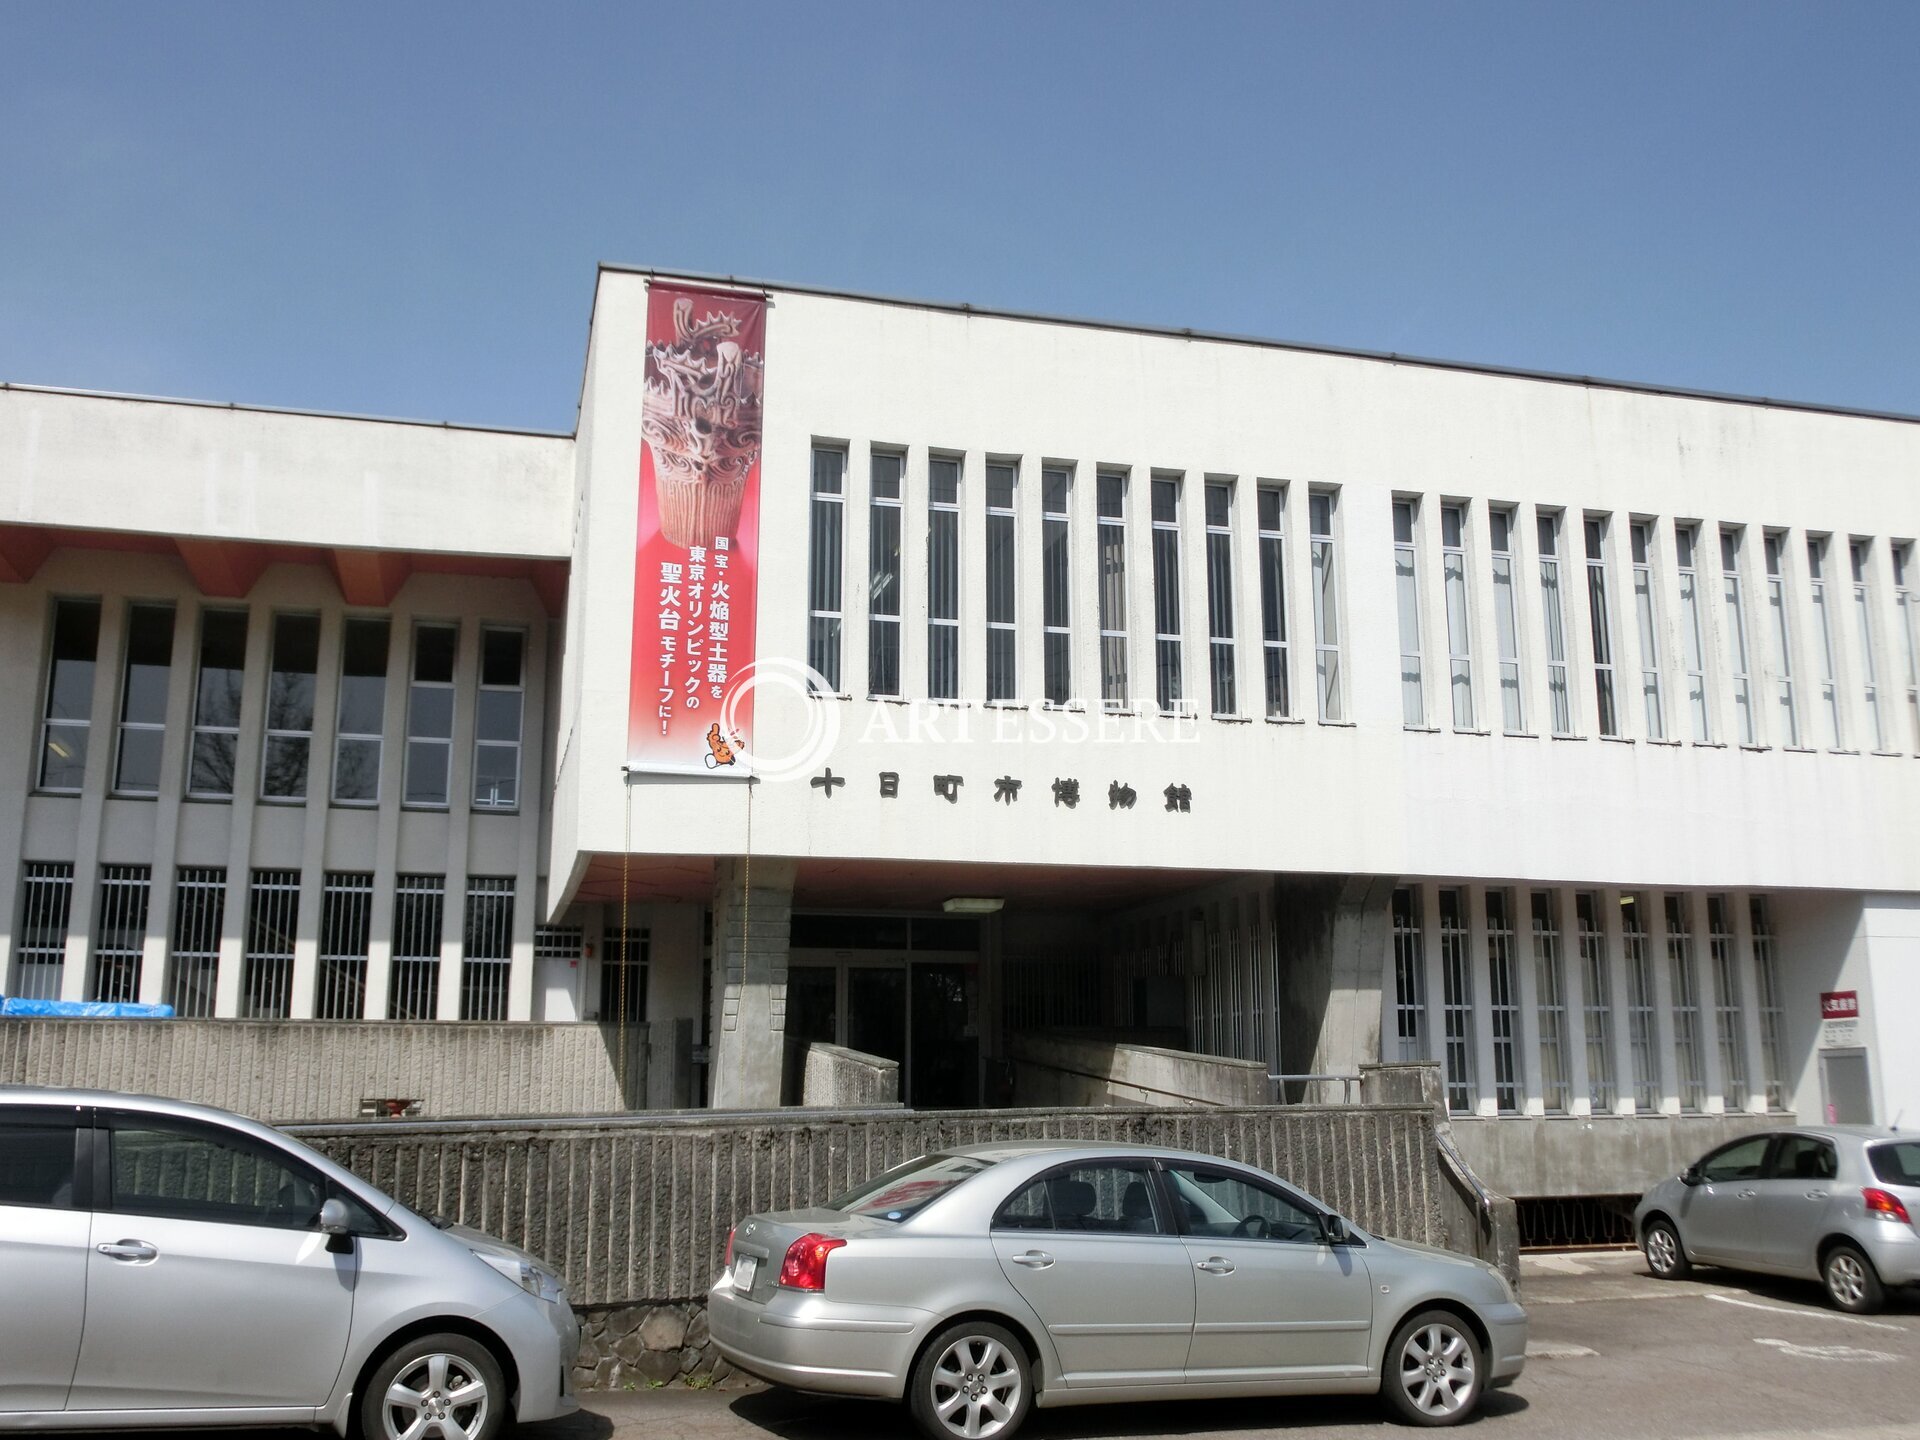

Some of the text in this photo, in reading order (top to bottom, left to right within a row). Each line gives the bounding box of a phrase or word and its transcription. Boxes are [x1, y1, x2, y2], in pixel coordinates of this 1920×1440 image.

[684, 546, 707, 709] 東京オリンピックの
[811, 767, 1192, 813] 十日町市博物館
